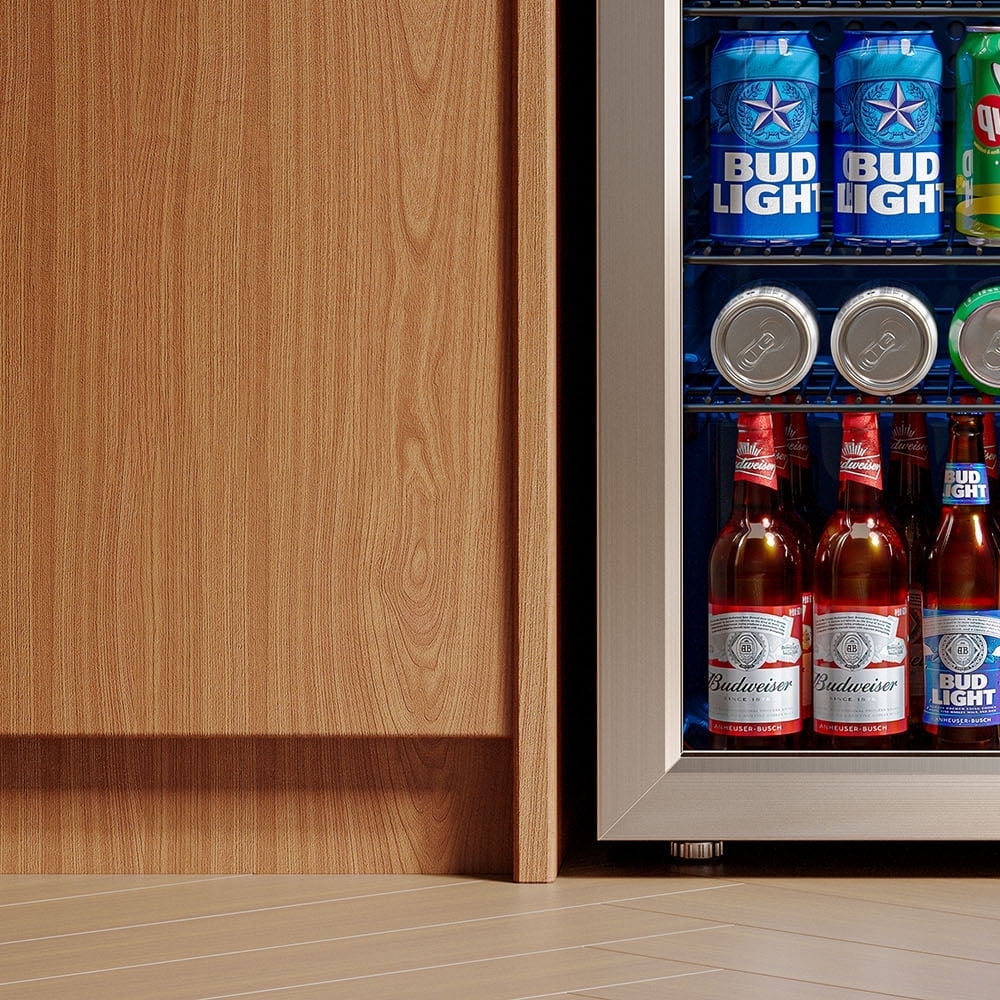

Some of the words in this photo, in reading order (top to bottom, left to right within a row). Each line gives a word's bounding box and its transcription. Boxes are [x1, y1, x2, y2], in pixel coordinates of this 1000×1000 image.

[724, 152, 816, 182] BUD
[846, 152, 940, 182] BUD
[890, 440, 928, 451] dweiser
[735, 458, 776, 470] dweiser
[840, 458, 881, 470] dweiser
[945, 470, 980, 484] BUD
[943, 484, 987, 498] IGHT
[709, 673, 792, 692] Budweiser
[814, 674, 899, 693] Budweiser
[940, 674, 988, 690] BUD
[930, 689, 996, 706] LIGHT
